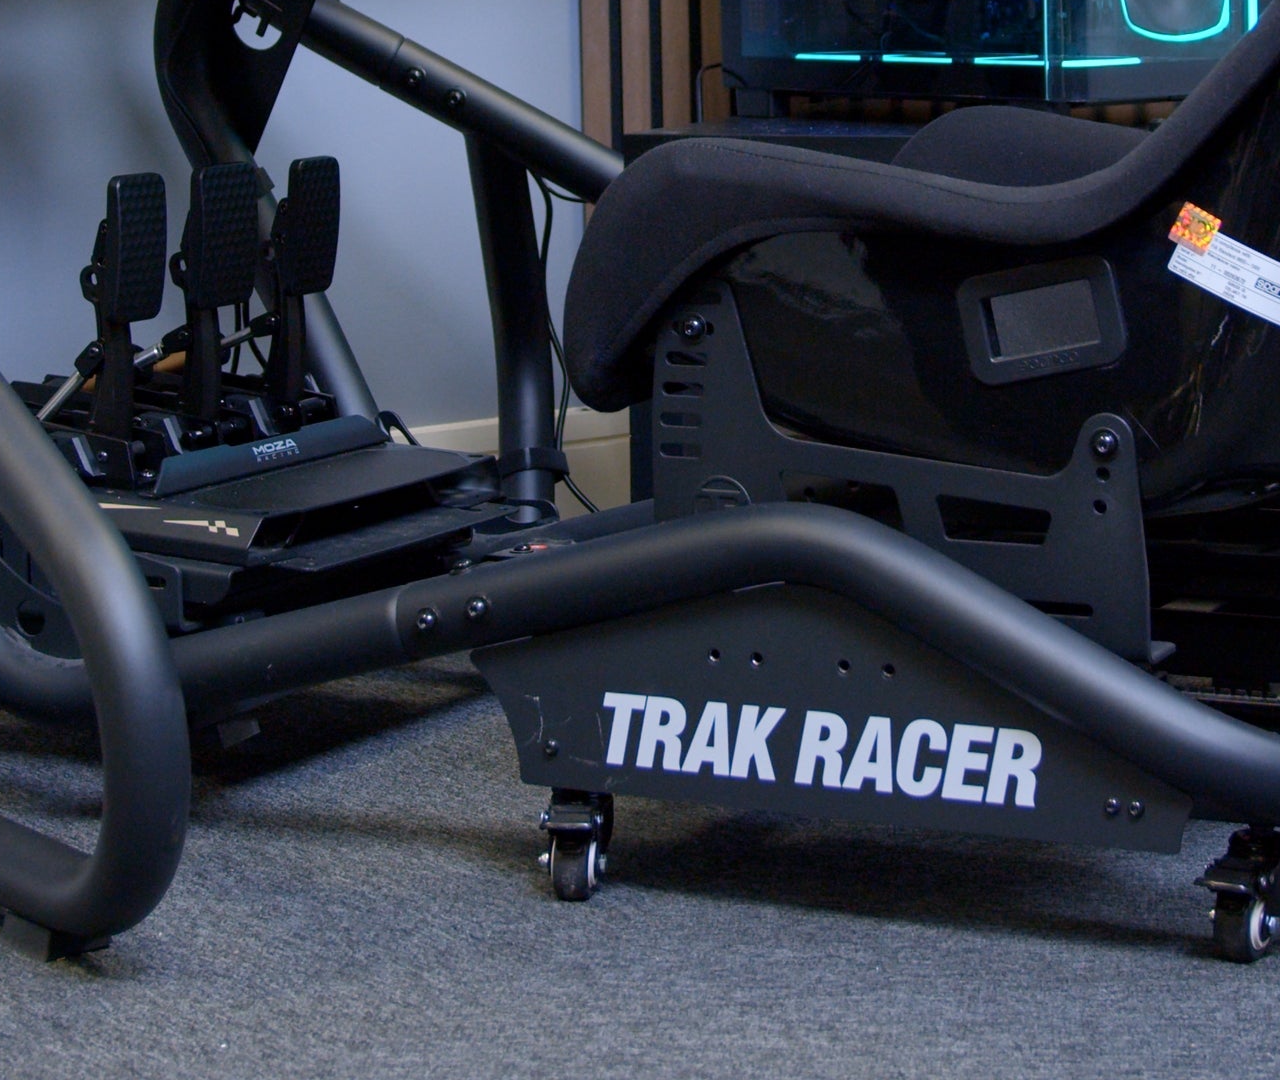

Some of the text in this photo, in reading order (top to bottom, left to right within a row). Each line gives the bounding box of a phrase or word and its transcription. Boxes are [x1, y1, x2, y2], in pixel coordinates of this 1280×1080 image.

[252, 438, 297, 456] MOZA
[602, 691, 1042, 808] TRAK RACER
